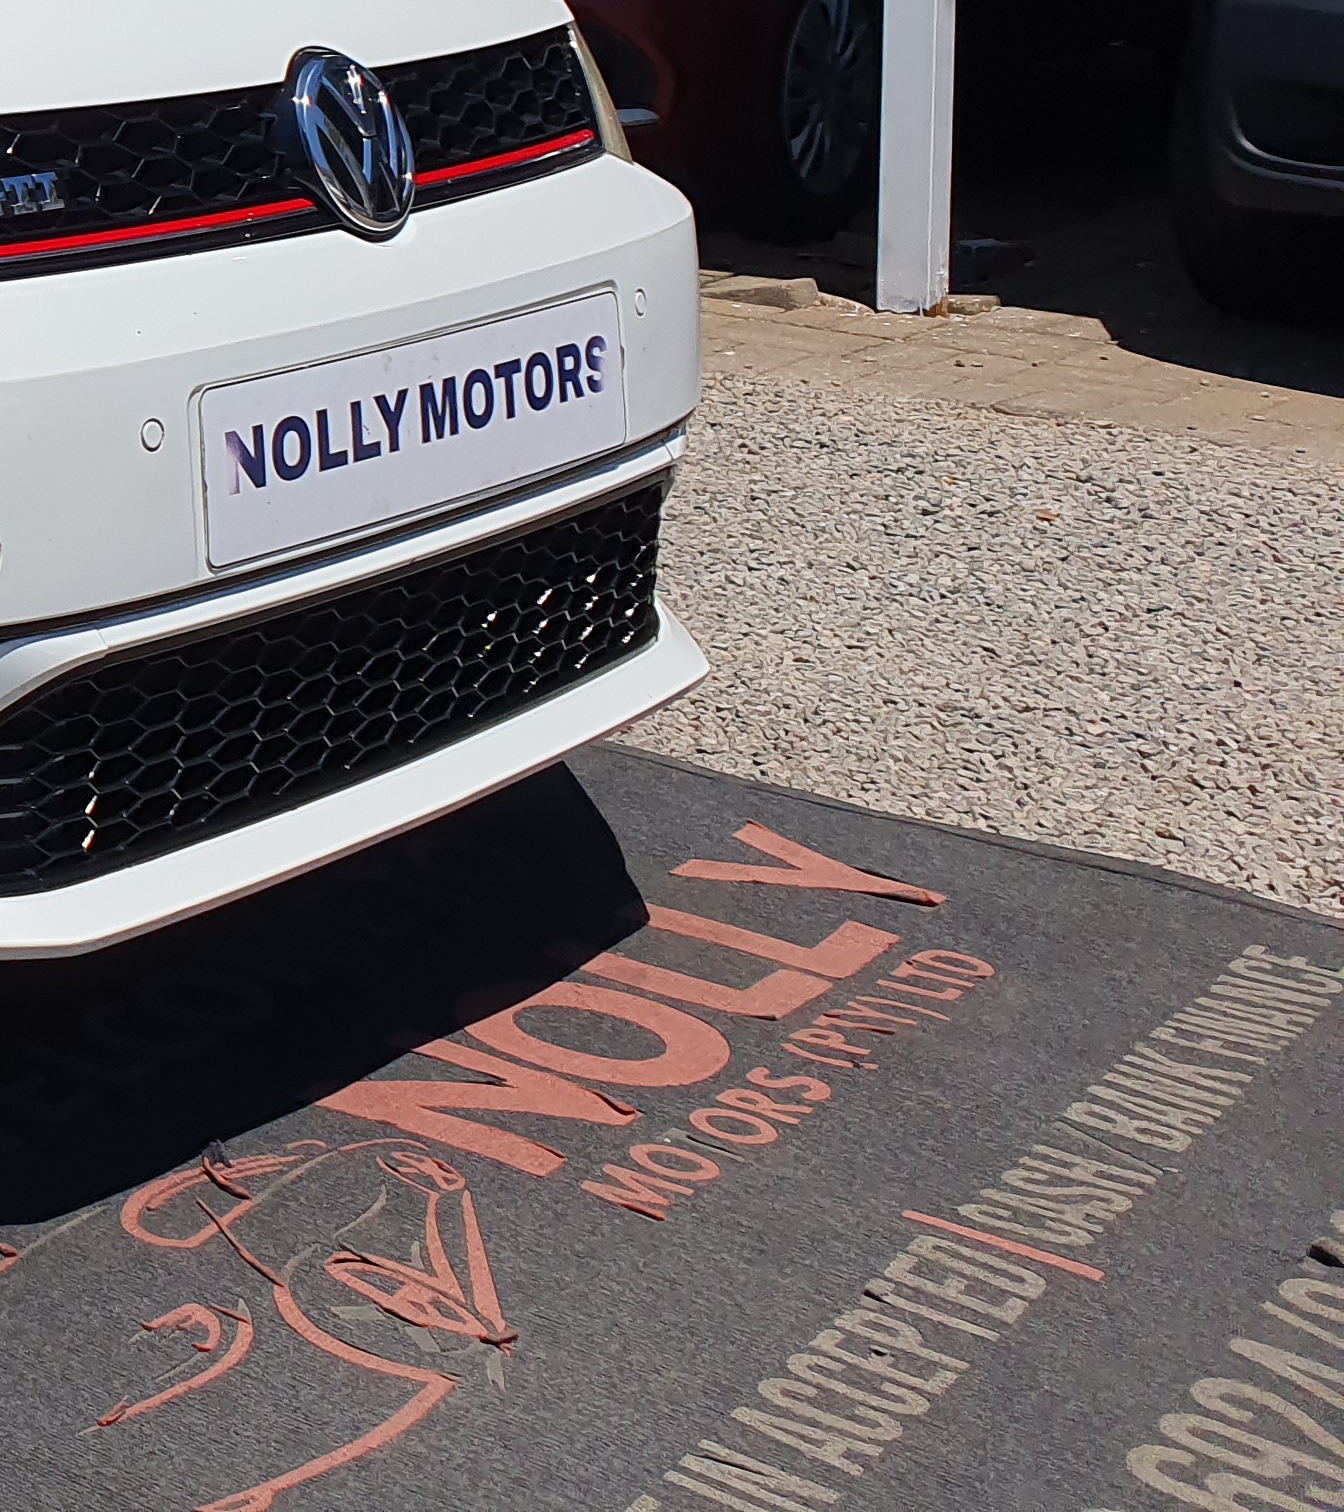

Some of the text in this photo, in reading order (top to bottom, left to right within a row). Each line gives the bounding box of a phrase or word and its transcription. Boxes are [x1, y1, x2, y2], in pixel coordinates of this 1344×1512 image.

[225, 335, 608, 495] NOLLY MOTORS
[315, 820, 948, 1178] NOLLY
[876, 949, 996, 1001] LTD
[731, 1235, 1047, 1476] ACCEPTED
